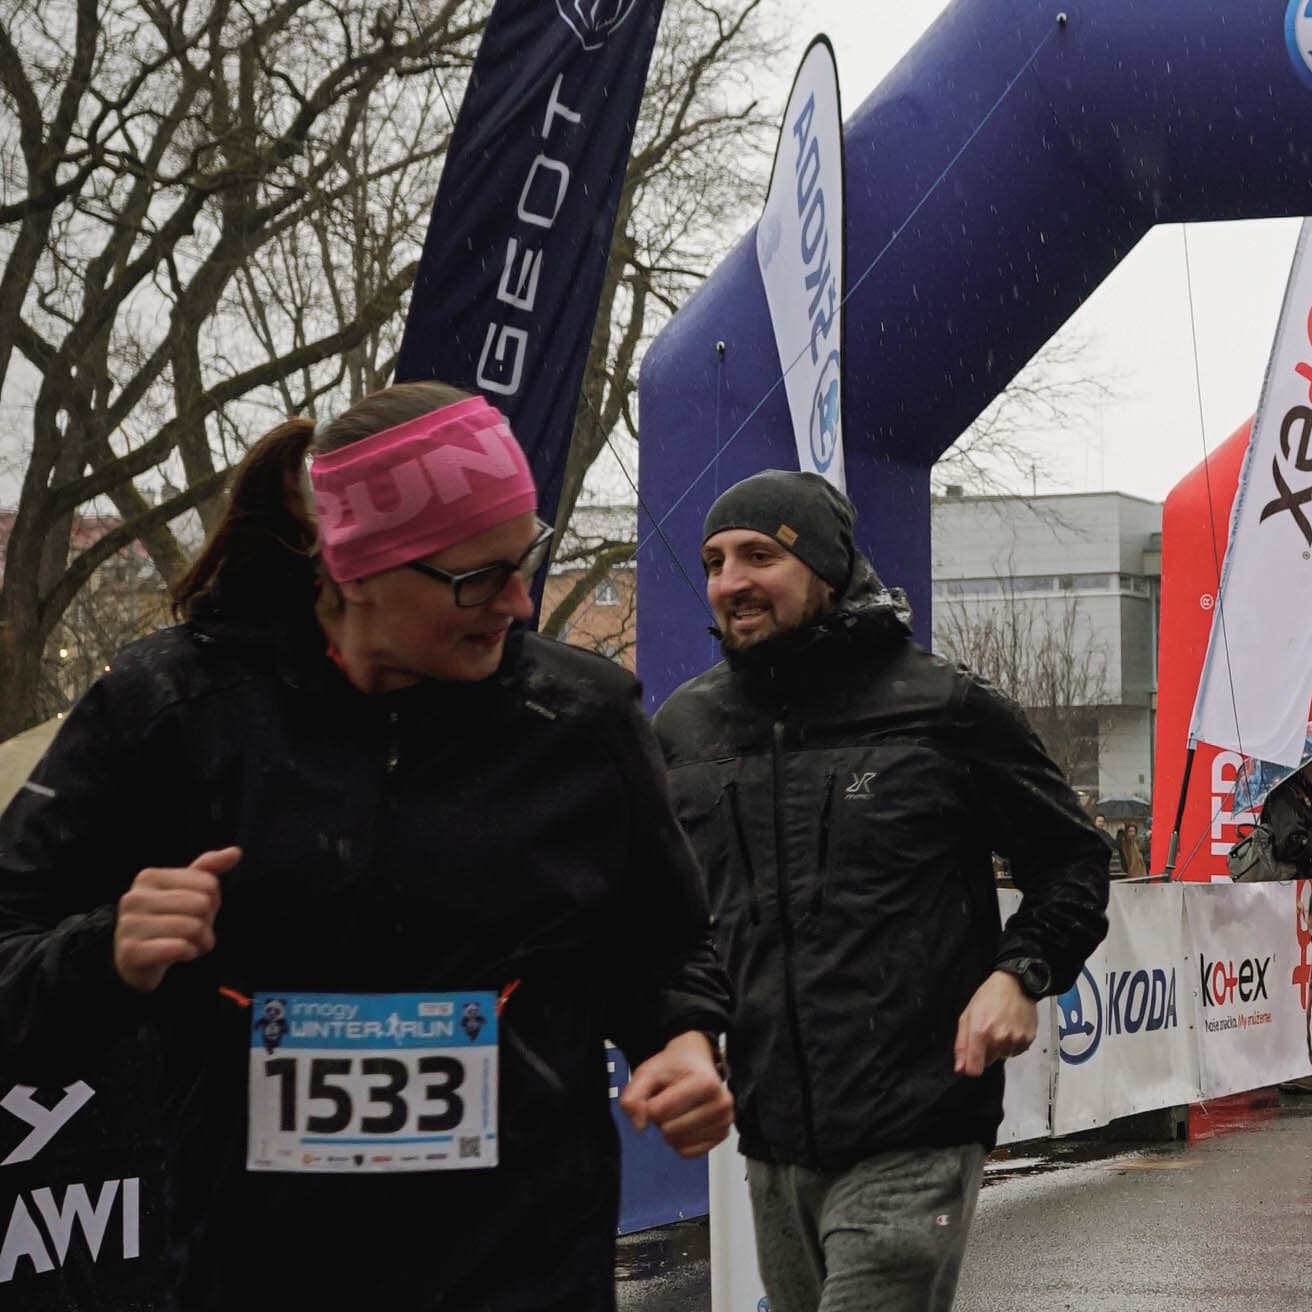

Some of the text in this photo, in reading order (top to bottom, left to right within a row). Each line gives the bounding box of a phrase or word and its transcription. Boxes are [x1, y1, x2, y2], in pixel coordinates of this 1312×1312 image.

[476, 73, 582, 396] GEOT
[291, 1002, 360, 1021] innogy
[403, 1021, 454, 1038] RUN
[1105, 967, 1178, 1036] KODA
[264, 1056, 466, 1135] 1533
